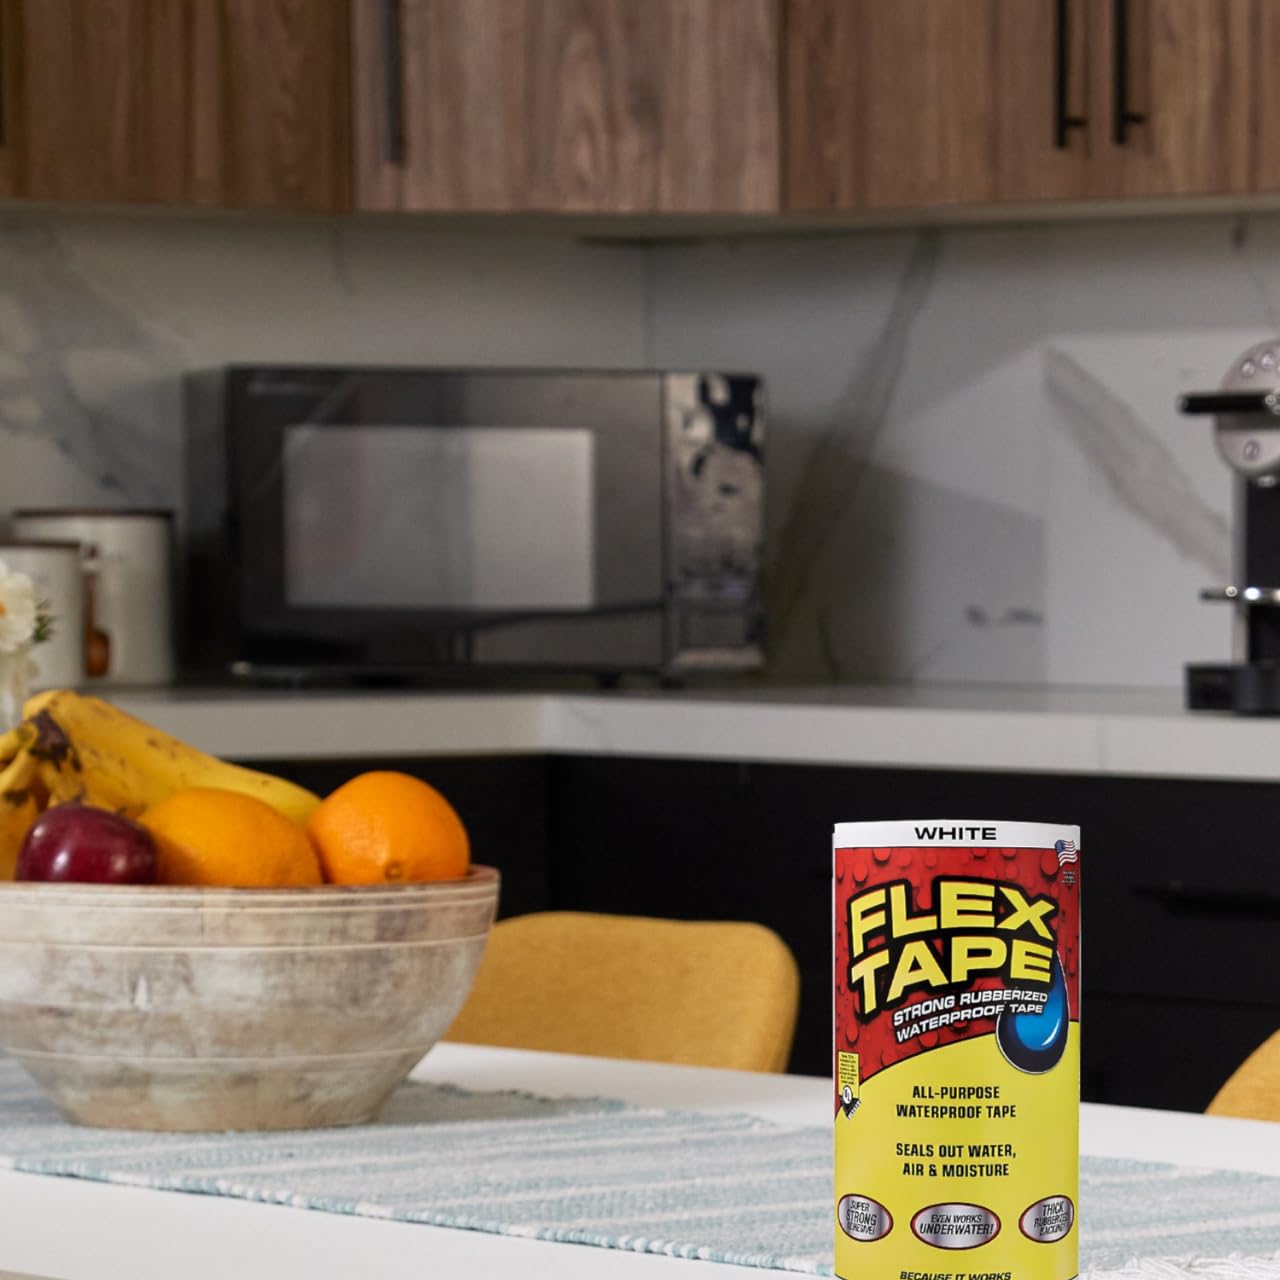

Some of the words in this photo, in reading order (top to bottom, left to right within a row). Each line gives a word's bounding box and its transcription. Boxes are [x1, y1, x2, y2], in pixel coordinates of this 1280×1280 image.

[914, 827, 997, 841] WHITE
[850, 880, 1056, 958] FLEX
[851, 936, 1053, 1015] TAPE
[893, 995, 956, 1027] STRONG
[959, 989, 1048, 1006] RUBBERIZED
[896, 1004, 1005, 1043] WATERPROOF
[1009, 1003, 1044, 1014] TAPE
[912, 1085, 1000, 1100] ALL-PURPOSE
[896, 1104, 982, 1119] WATERPROOF
[986, 1105, 1017, 1119] TAPE
[896, 1143, 934, 1158] SEALS
[938, 1144, 964, 1158] OUT
[968, 1144, 1017, 1159] WATER,
[902, 1162, 924, 1177] AIR
[928, 1164, 938, 1178] &
[942, 1163, 1010, 1178] MOISTURE
[846, 1208, 877, 1226] STRONG
[931, 1214, 951, 1223] EVEN
[953, 1215, 983, 1224] WORKS
[920, 1223, 994, 1235] UNDERWATER!
